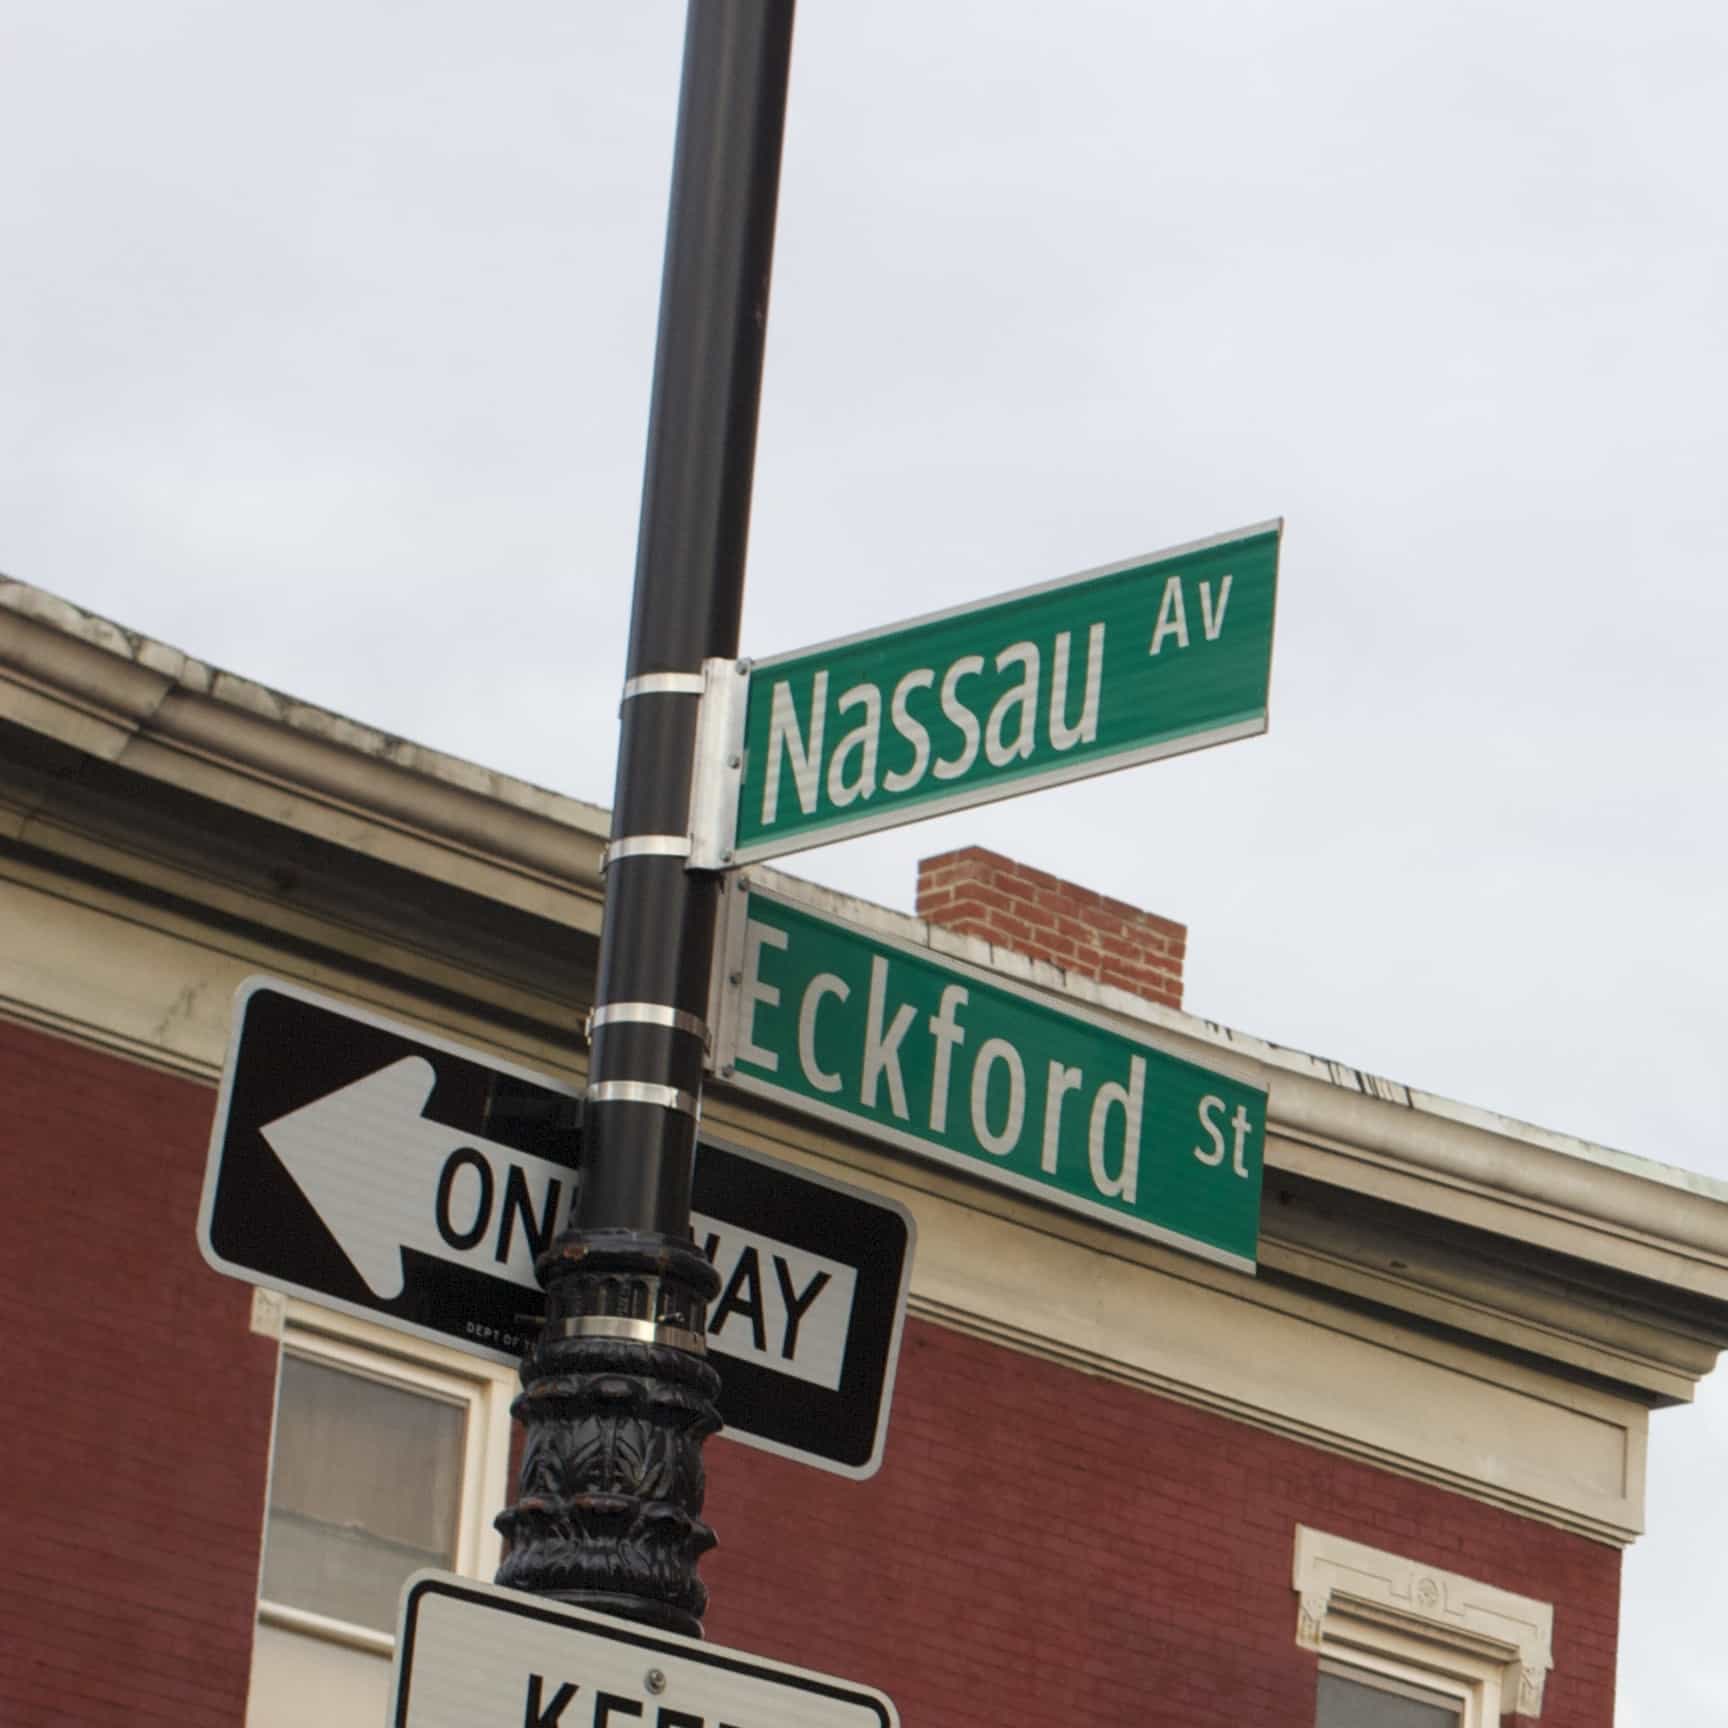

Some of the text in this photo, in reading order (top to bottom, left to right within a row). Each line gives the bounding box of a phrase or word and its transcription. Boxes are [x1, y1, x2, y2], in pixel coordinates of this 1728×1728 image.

[760, 574, 1235, 826] Nassau Av
[735, 917, 1253, 1205] Eckford St
[434, 1146, 833, 1361] ON AY
